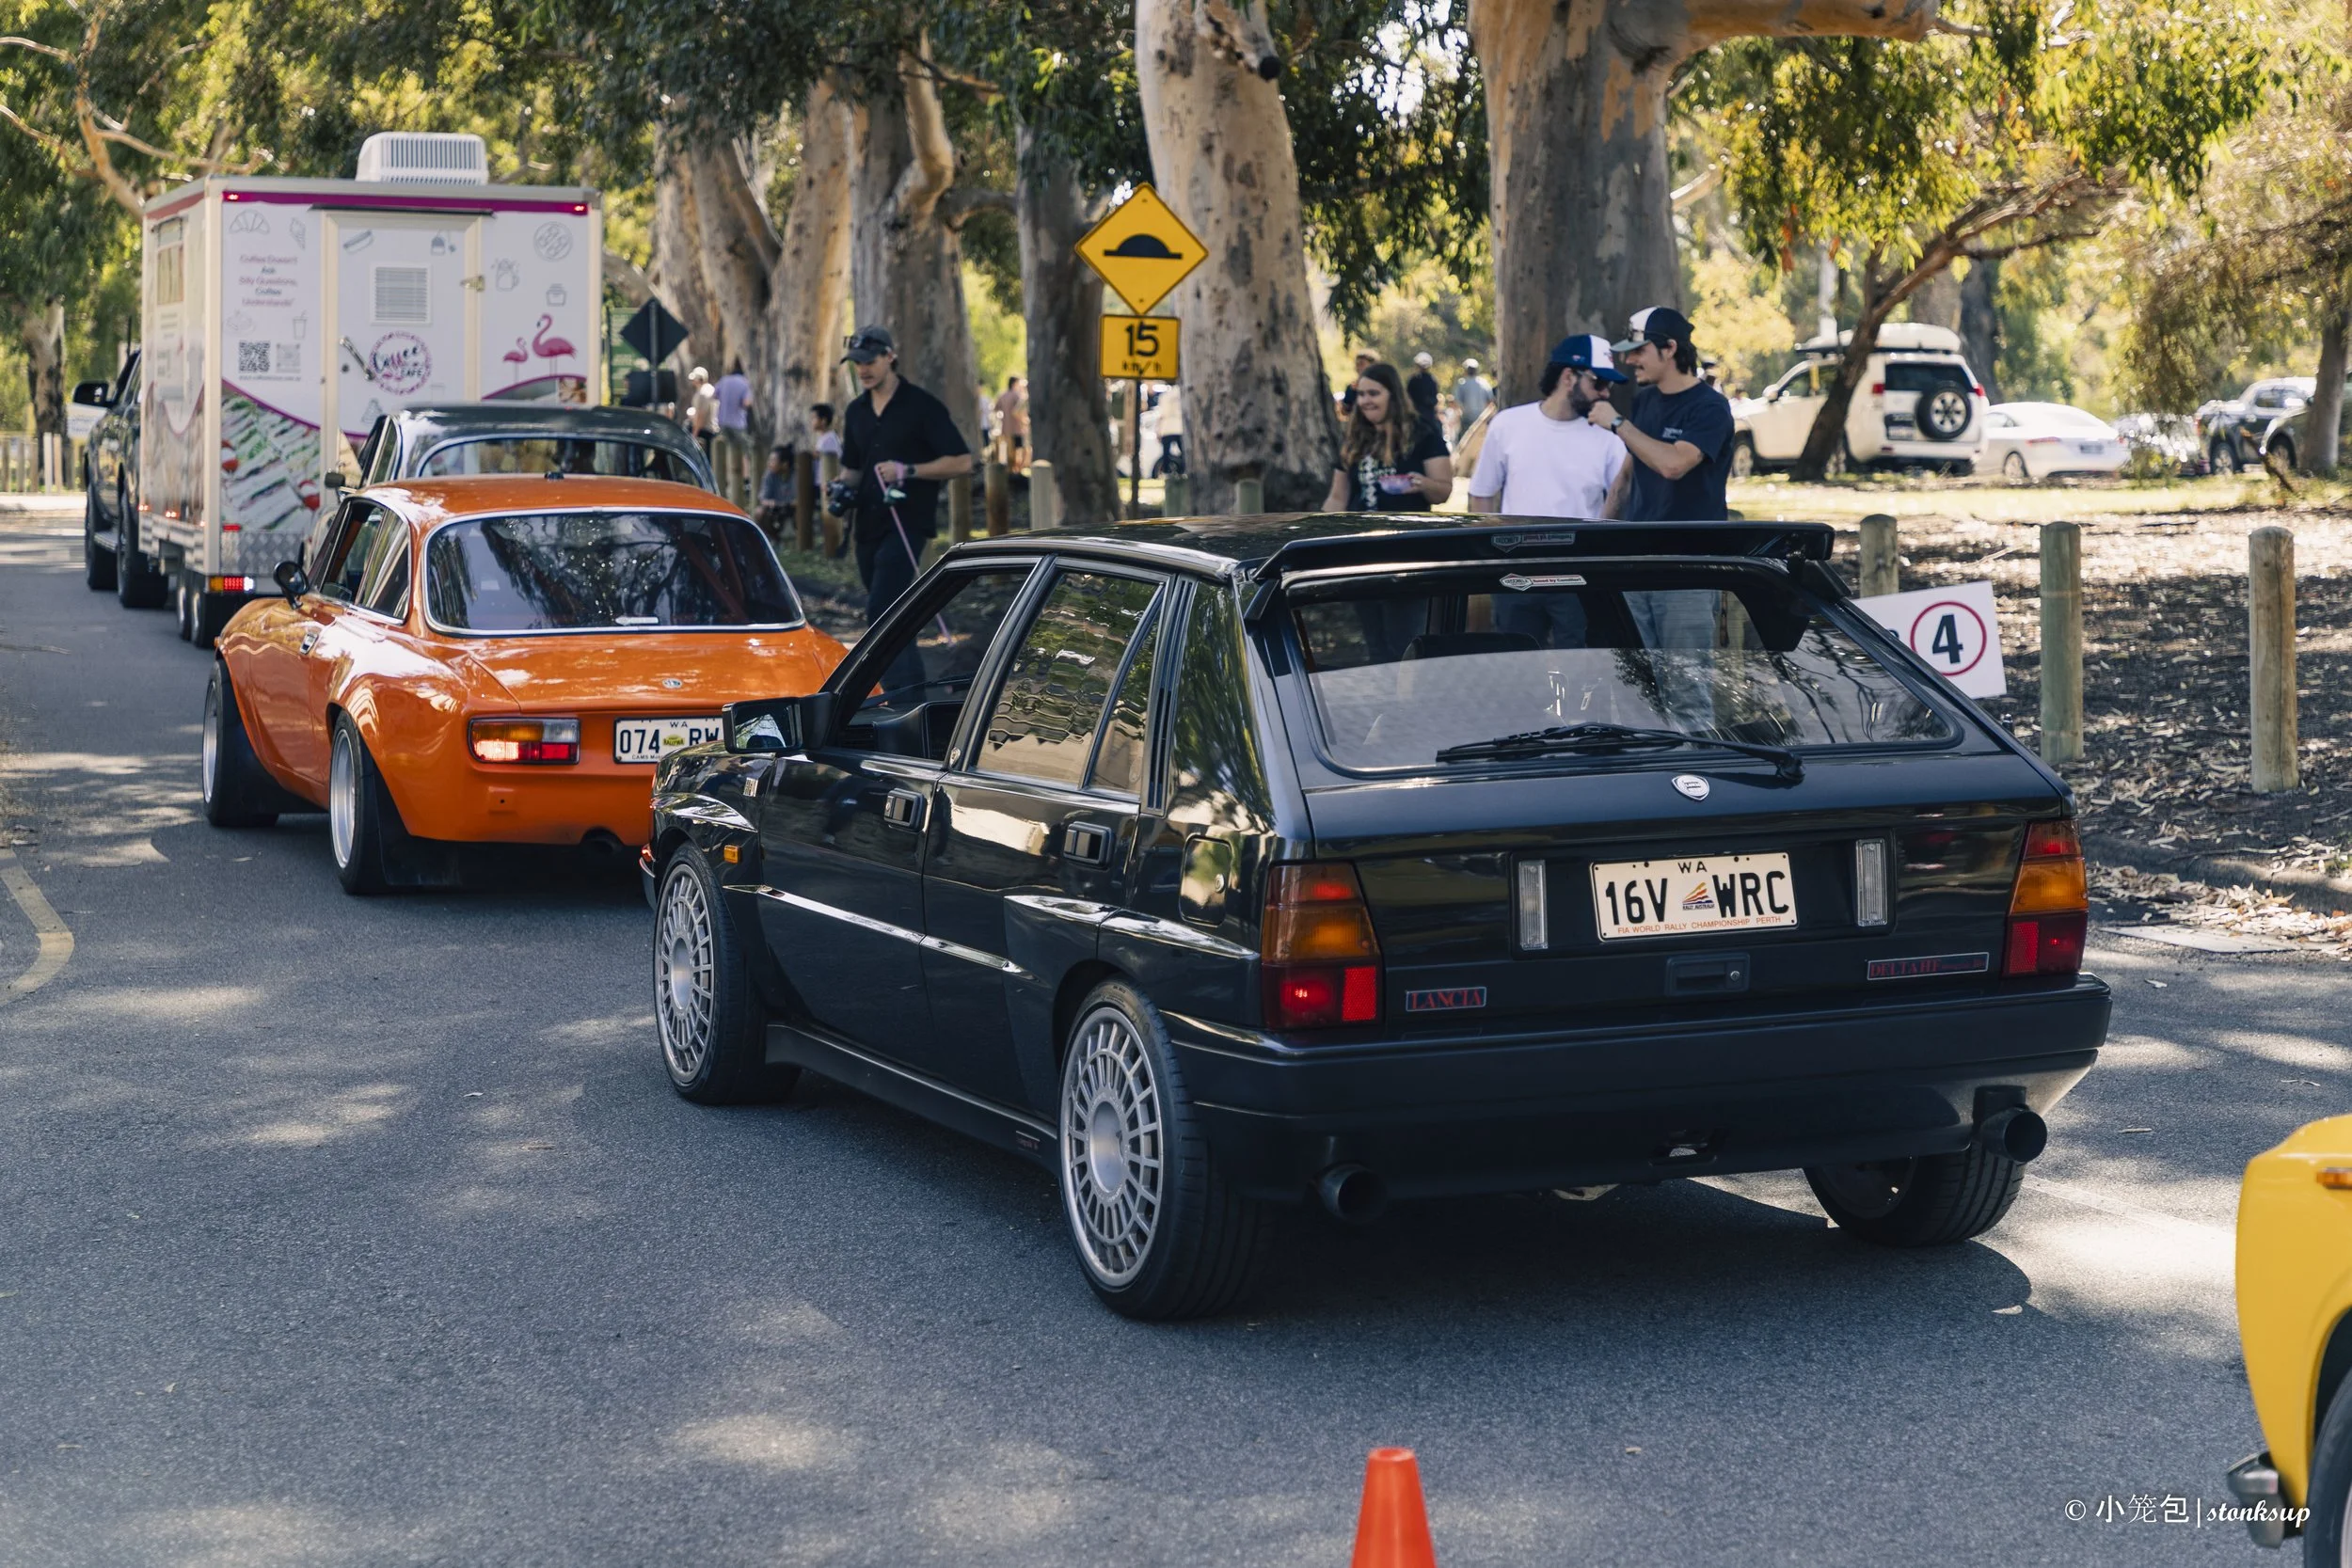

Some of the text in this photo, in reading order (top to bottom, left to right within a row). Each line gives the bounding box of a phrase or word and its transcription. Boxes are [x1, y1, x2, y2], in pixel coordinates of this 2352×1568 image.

[1125, 322, 1160, 356] 15
[1121, 361, 1162, 375] km/h
[1931, 613, 1963, 664] 4
[620, 729, 660, 754] 074
[1677, 861, 1708, 874] WA
[1605, 870, 1789, 926] 16V WRC
[1632, 925, 1661, 933] WORLD
[1692, 918, 1751, 929] CHAMPIONSHIP
[1411, 989, 1483, 1009] LANCIA
